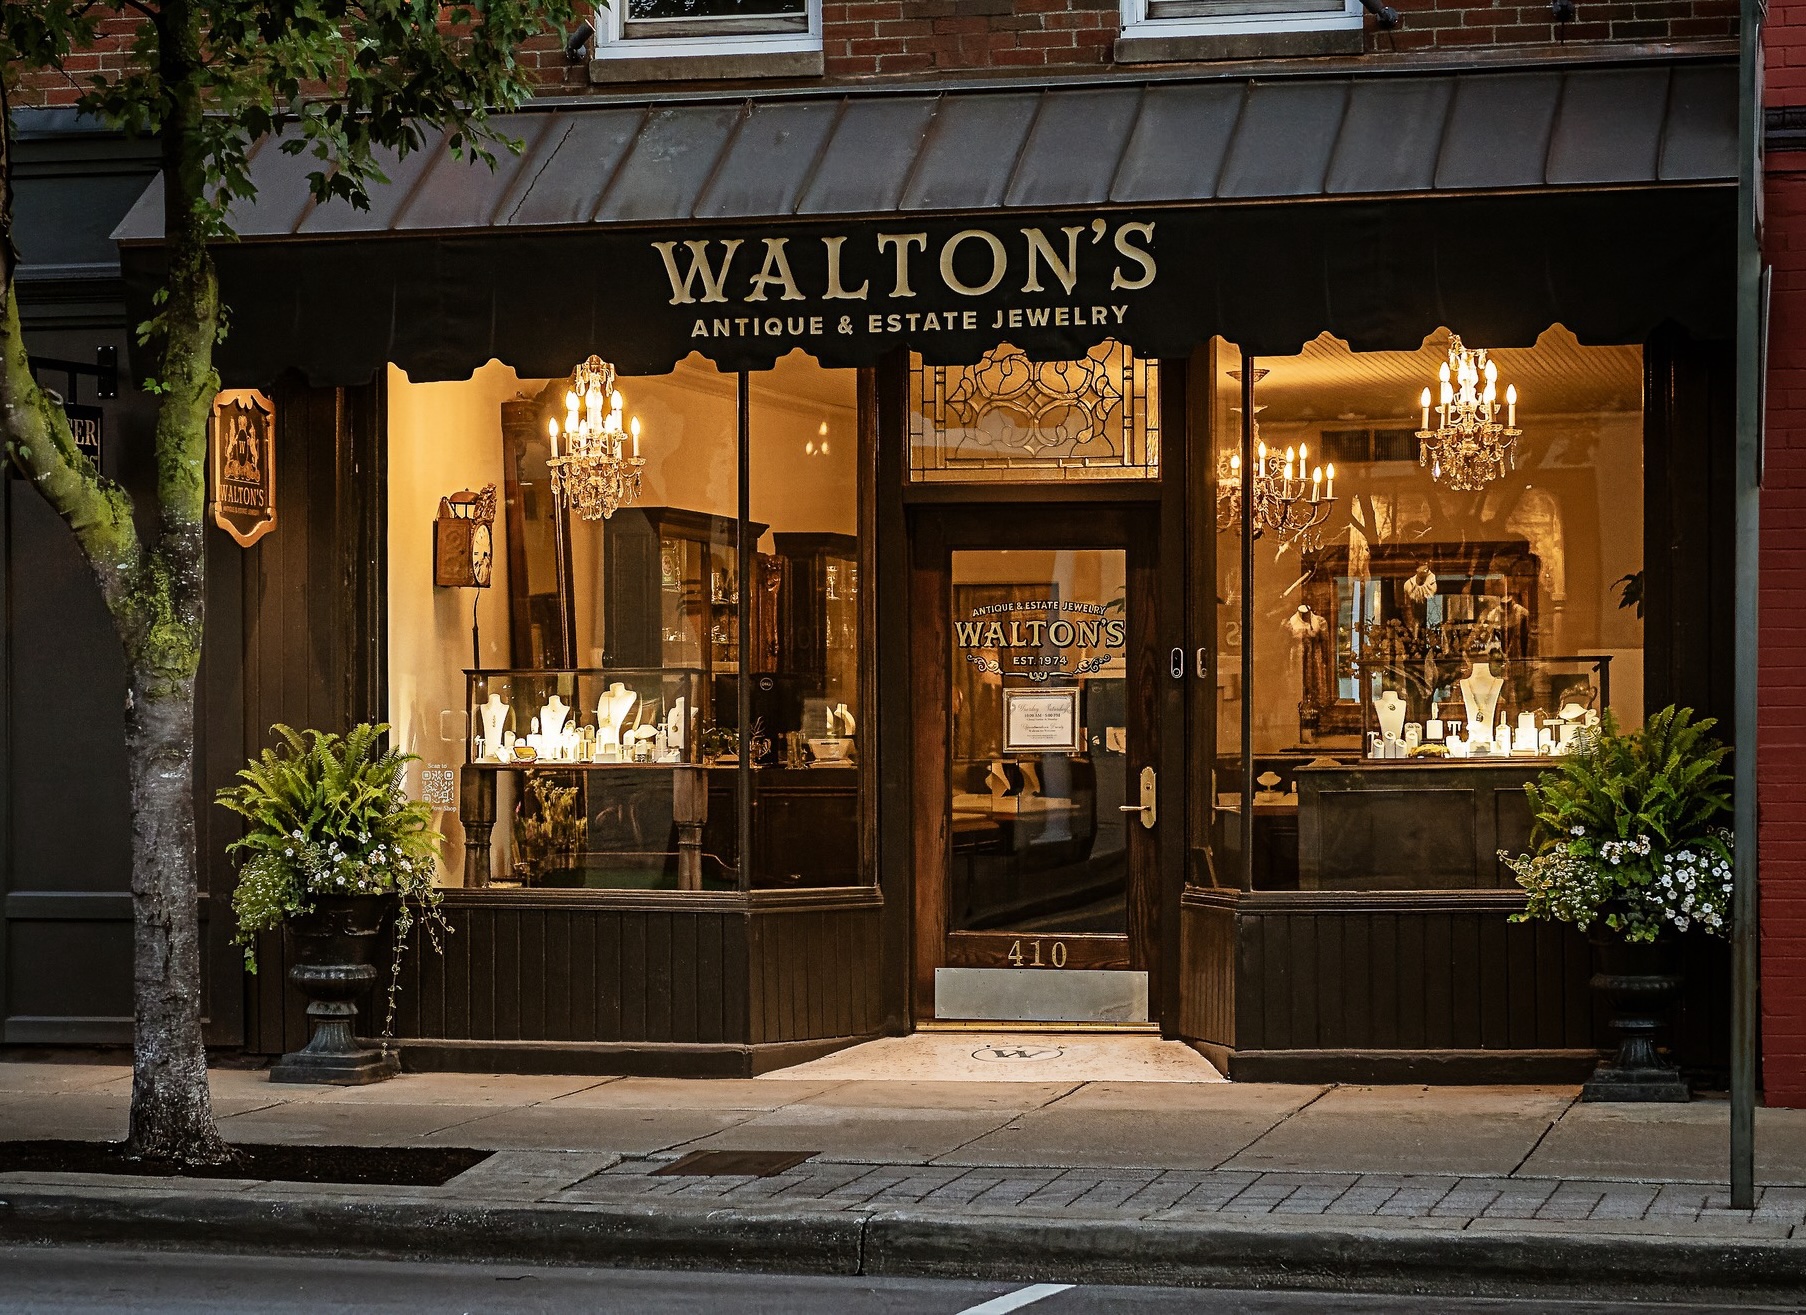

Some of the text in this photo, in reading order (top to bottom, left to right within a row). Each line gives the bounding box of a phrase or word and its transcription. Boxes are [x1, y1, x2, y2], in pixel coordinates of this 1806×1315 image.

[651, 218, 1157, 305] WALTON'S
[690, 305, 1129, 338] ANTIQUE & ESTATE JEWELRY
[220, 484, 265, 507] WALTON'S
[972, 601, 1106, 617] ANTIQUE & ESTATE JEWELRY
[954, 618, 1126, 648] WALTON'S
[1013, 656, 1068, 666] EST. 1974
[1008, 940, 1067, 968] 410
[992, 1050, 1050, 1058] W
